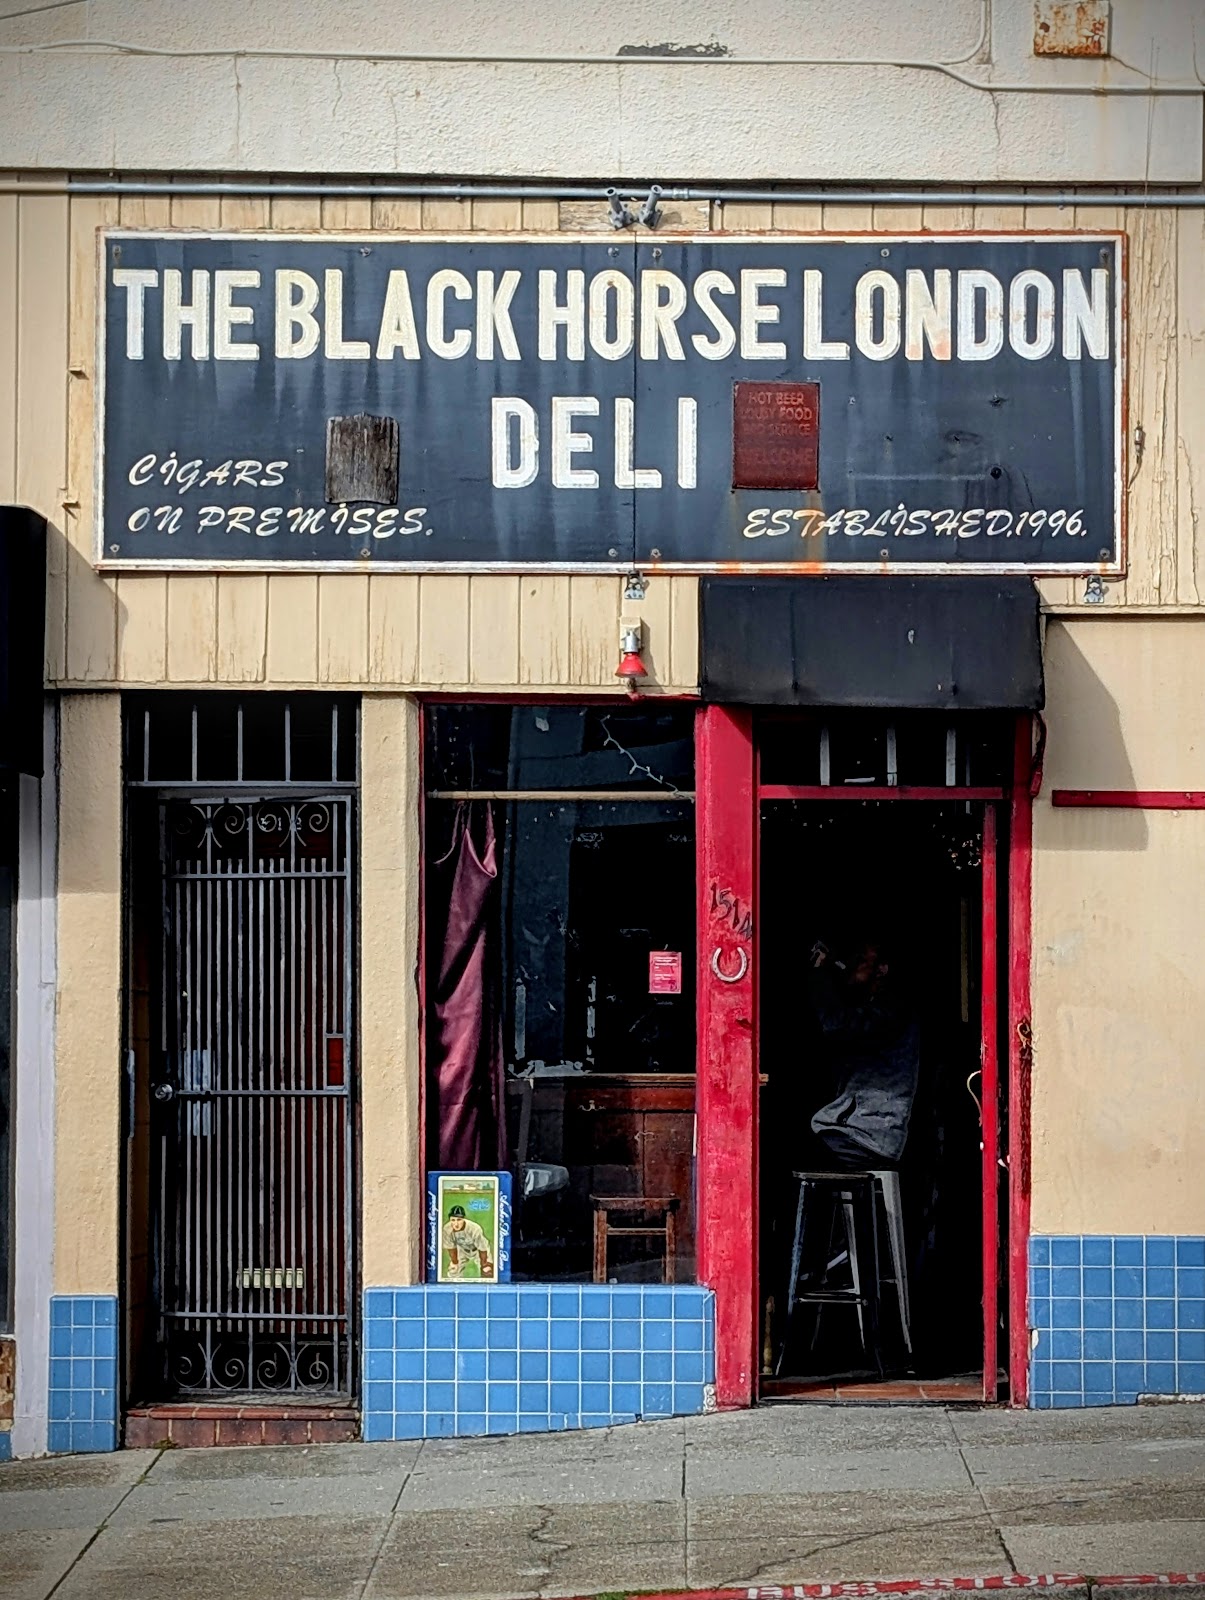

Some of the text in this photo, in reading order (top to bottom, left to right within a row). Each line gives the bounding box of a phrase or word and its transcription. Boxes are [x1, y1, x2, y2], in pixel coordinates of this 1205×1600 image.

[112, 268, 1110, 362] THE BLACK HORSE LONDON
[748, 391, 805, 406] HOT BEER
[779, 406, 813, 420] FOOD
[491, 397, 698, 489] DELI
[128, 505, 182, 534] ON
[710, 882, 752, 941] 1514
[748, 1582, 878, 1600] BUS
